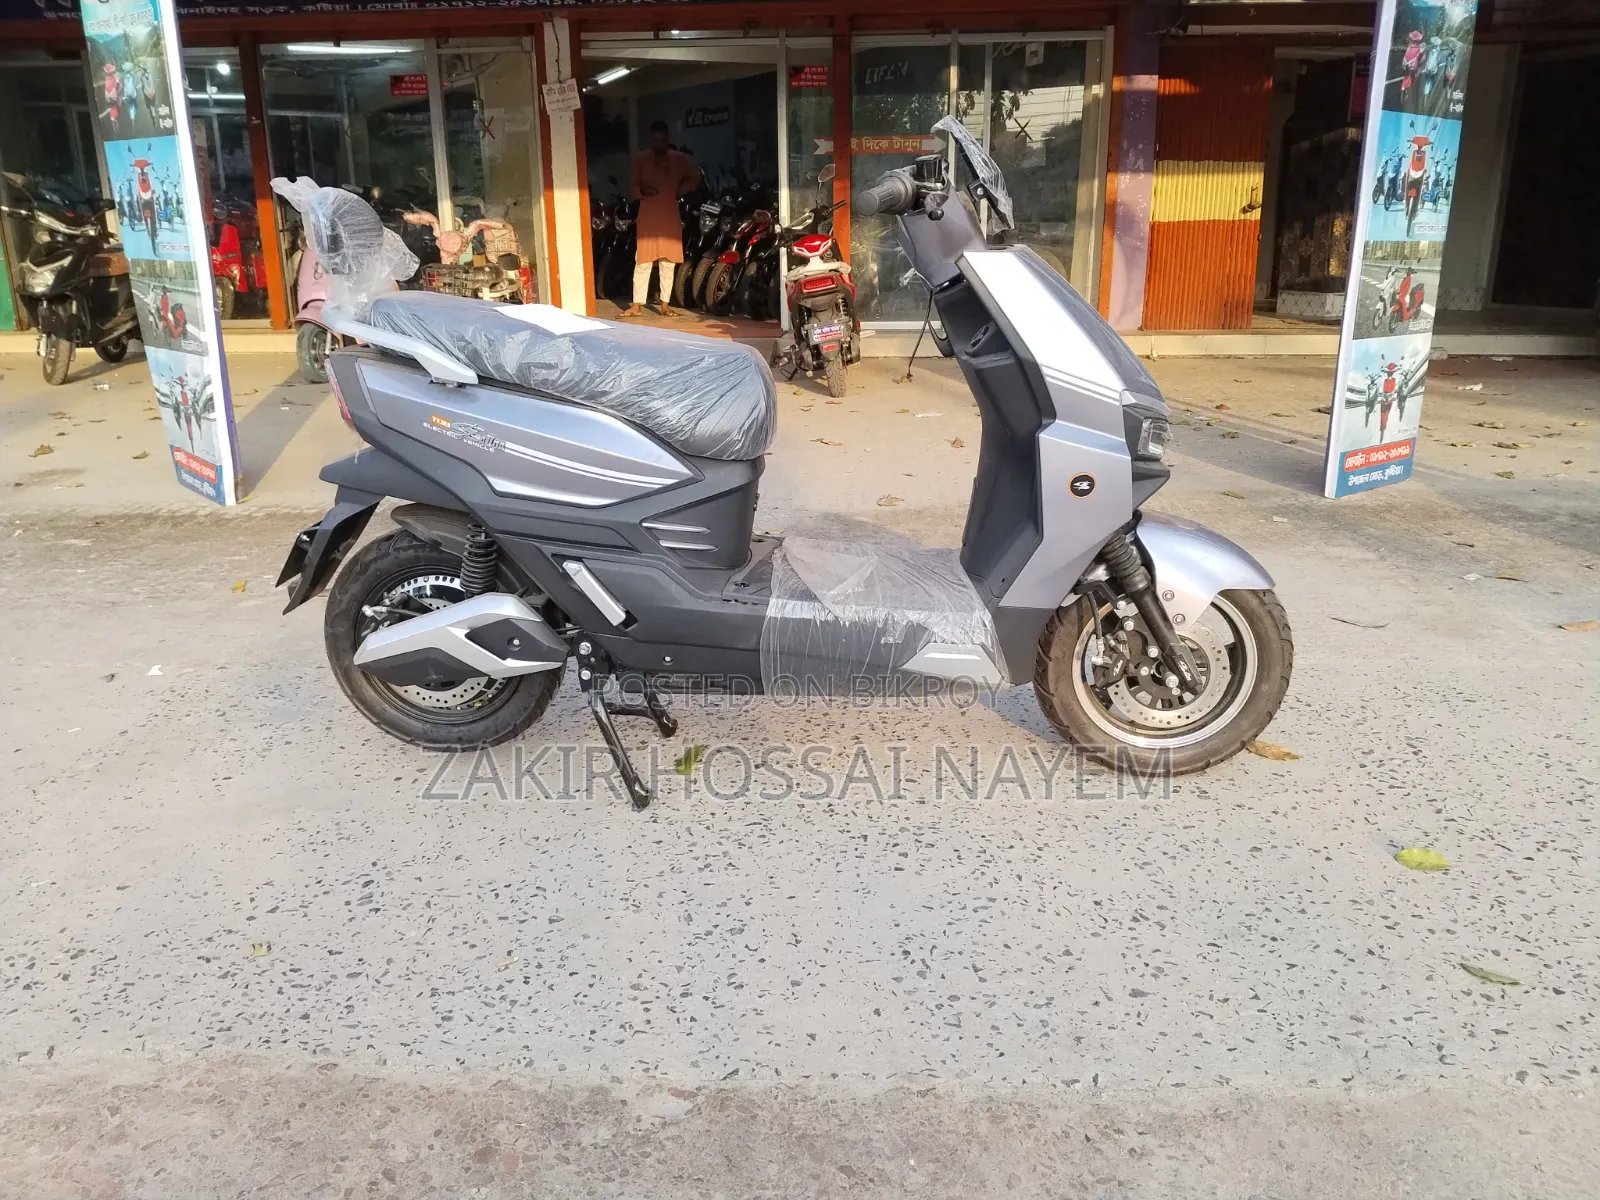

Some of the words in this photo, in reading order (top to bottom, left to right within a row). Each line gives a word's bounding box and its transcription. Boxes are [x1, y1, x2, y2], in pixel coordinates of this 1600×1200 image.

[862, 136, 889, 150] দিকে
[893, 136, 921, 152] টানুন
[422, 421, 459, 440] ELECTRIC
[463, 438, 495, 453] VEHICLE
